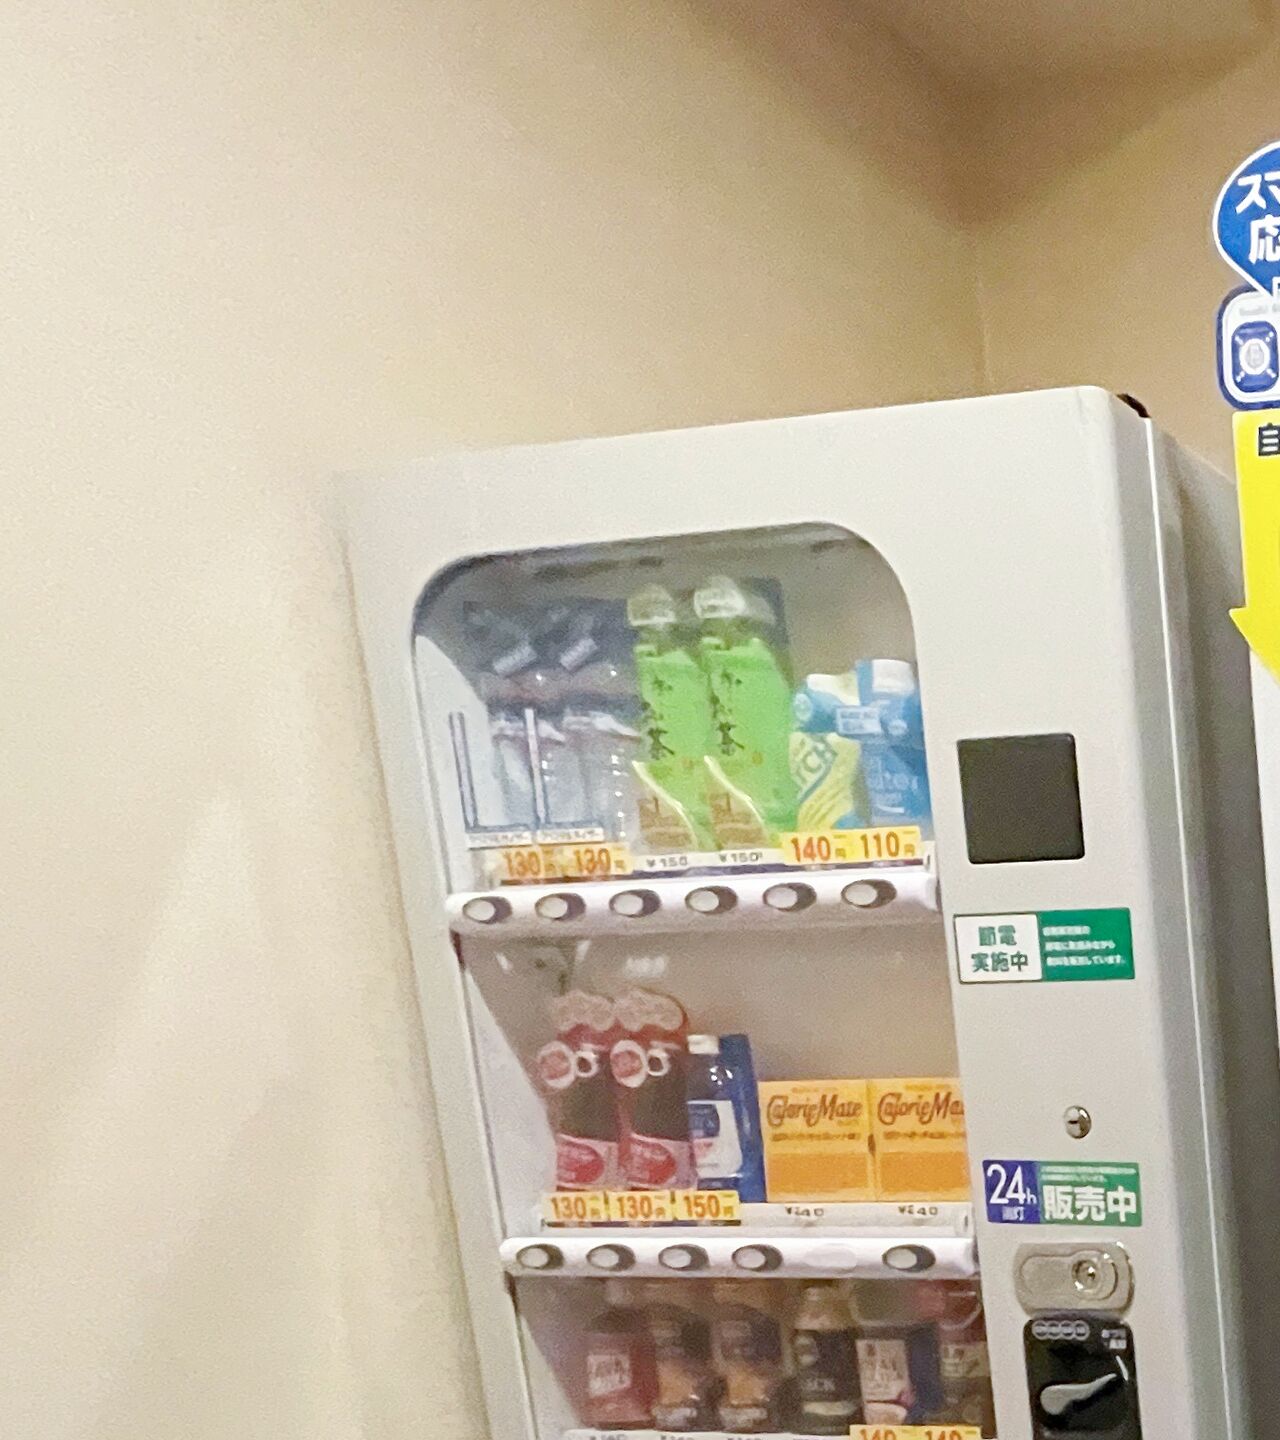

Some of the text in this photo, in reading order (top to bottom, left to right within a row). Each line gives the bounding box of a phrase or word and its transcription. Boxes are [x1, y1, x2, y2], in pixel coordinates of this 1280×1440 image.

[978, 924, 1019, 947] 節電
[970, 950, 1029, 973] 実施中
[986, 1162, 1037, 1206] 24h
[1042, 1184, 1138, 1223] 販売中
